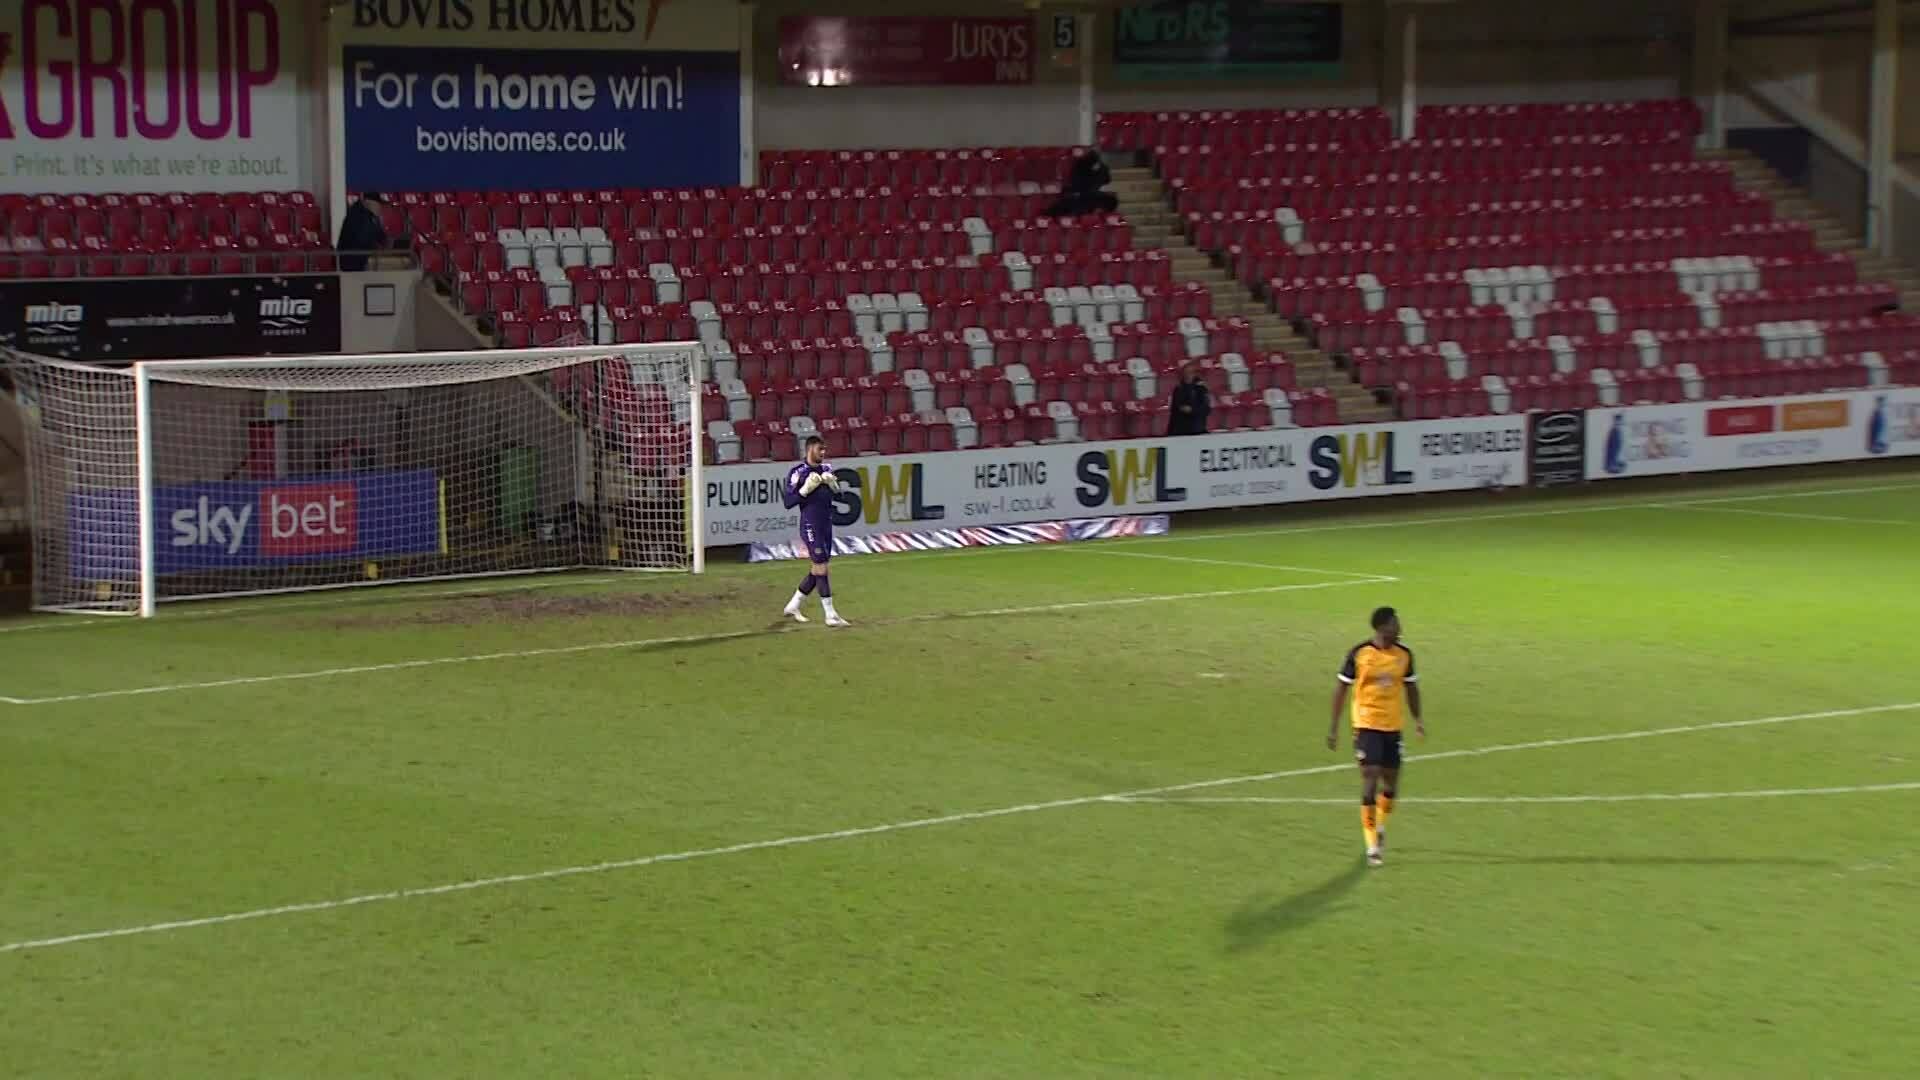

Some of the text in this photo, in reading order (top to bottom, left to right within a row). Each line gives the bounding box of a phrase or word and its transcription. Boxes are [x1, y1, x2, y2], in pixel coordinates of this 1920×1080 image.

[353, 0, 636, 33] BOVIS HOMES
[945, 20, 1028, 62] JURYS
[1055, 18, 1073, 47] 5
[354, 60, 685, 111] For a home win!
[416, 126, 627, 152] bovishomes.co.uk
[74, 154, 105, 176] It's
[112, 154, 161, 176] what
[169, 154, 220, 176] we're
[25, 301, 84, 323] mira
[259, 295, 313, 317] mira
[1420, 428, 1522, 457] RENEWABLES
[1199, 442, 1297, 473] ELECTRICAL
[974, 461, 1048, 488] HEATING
[706, 477, 786, 508] PLUMBIN
[171, 494, 347, 555] sky bet
